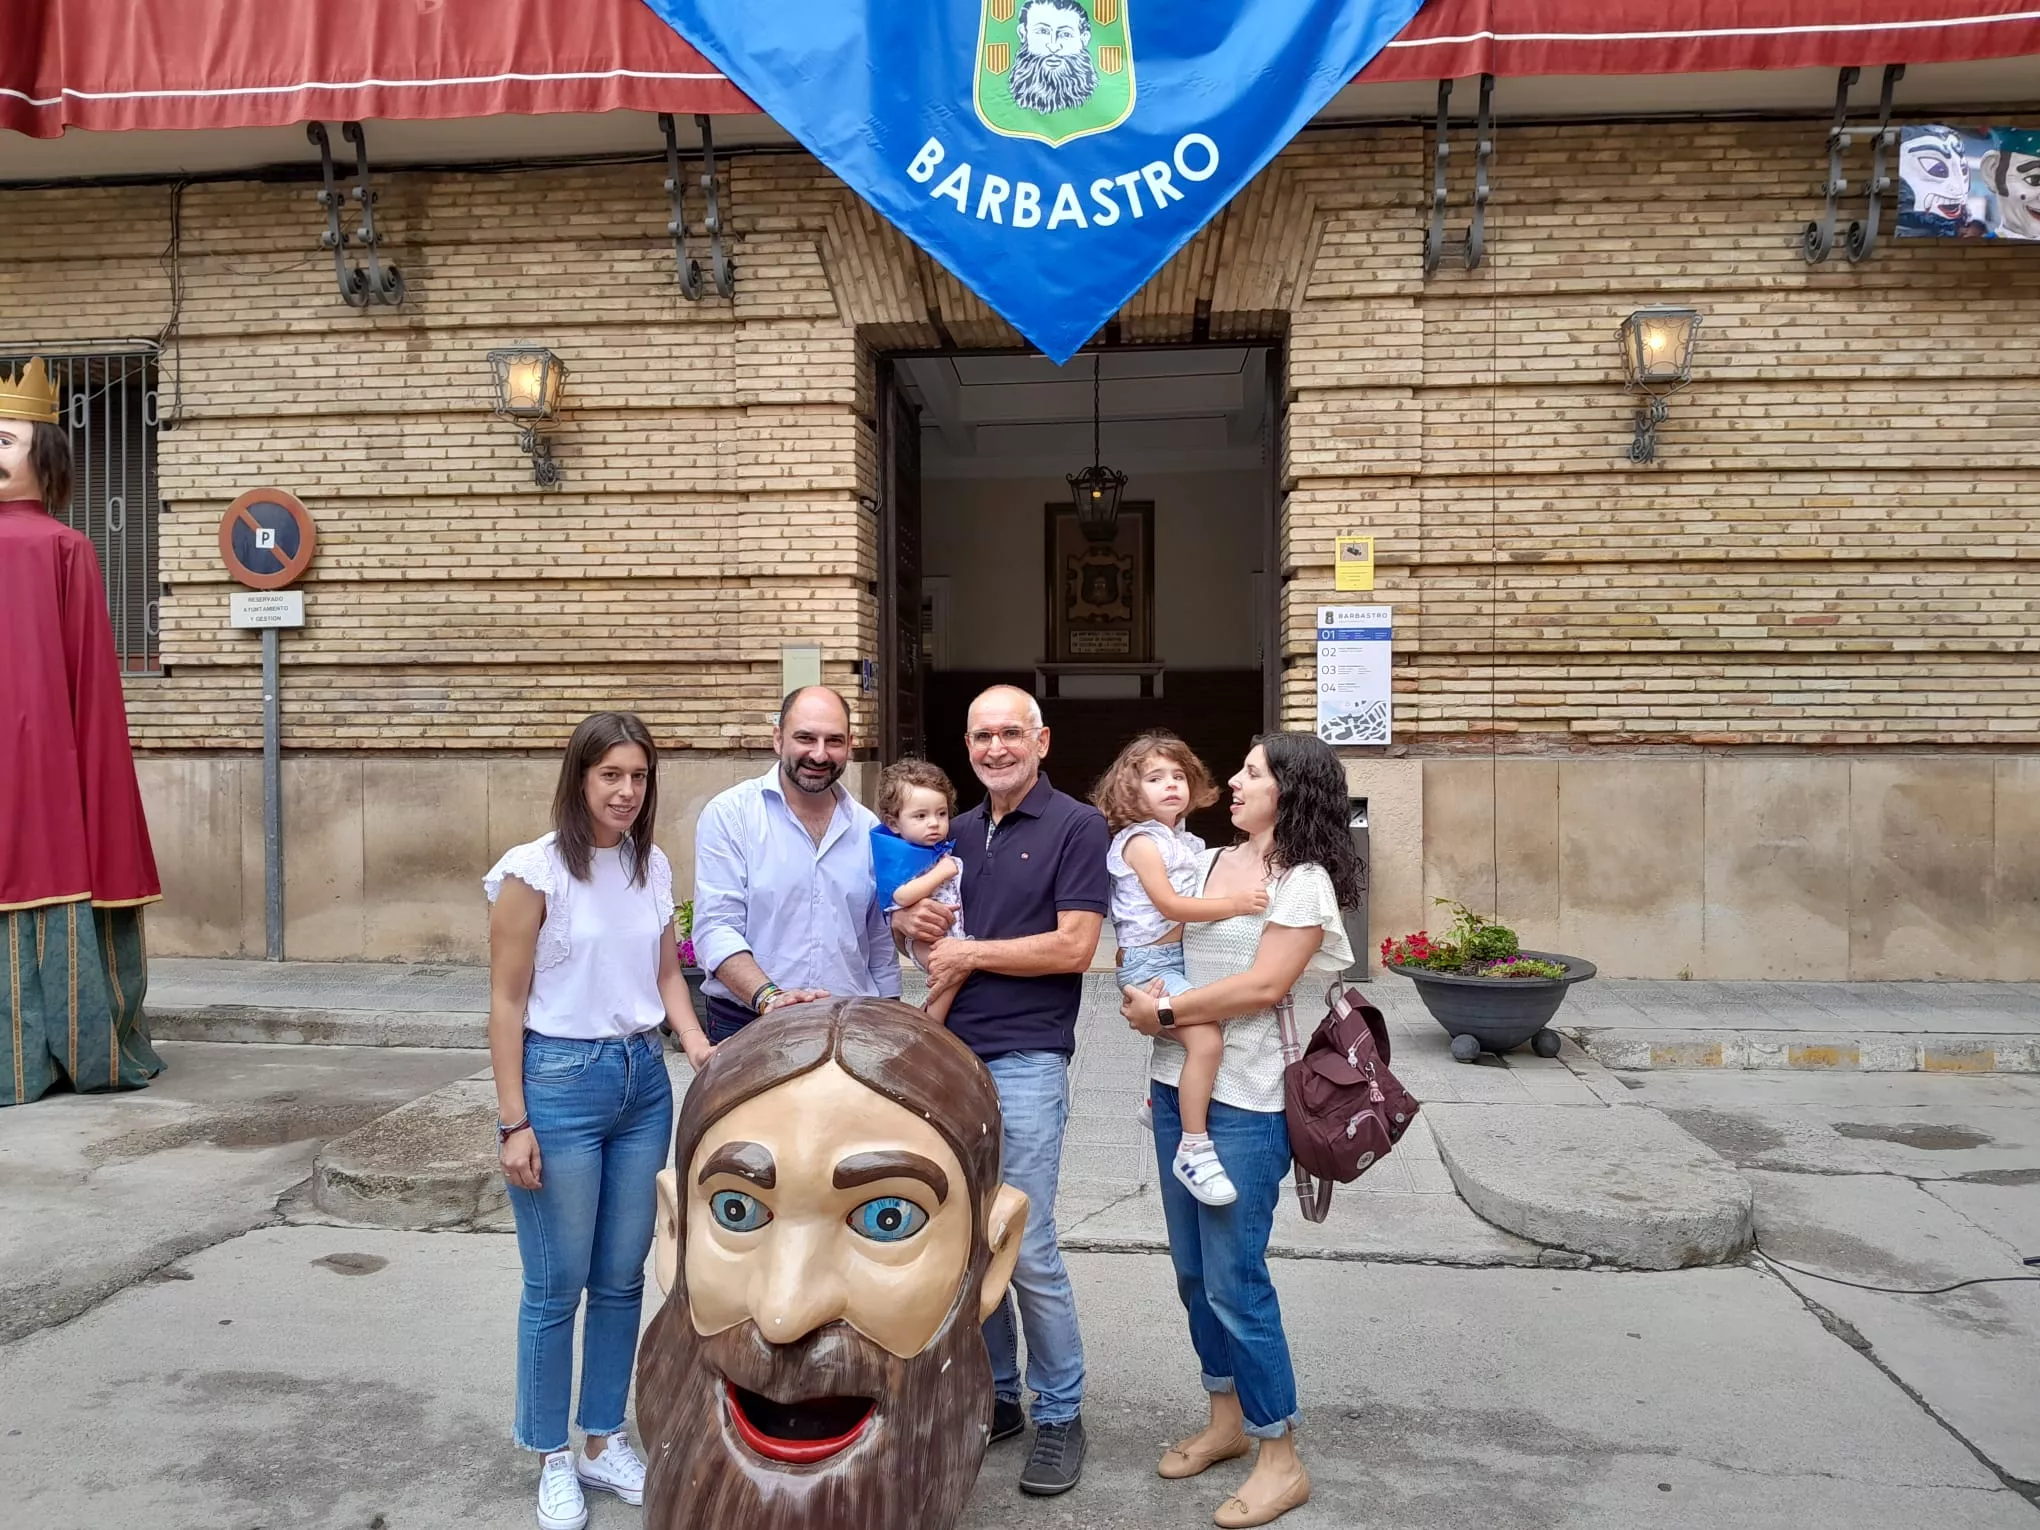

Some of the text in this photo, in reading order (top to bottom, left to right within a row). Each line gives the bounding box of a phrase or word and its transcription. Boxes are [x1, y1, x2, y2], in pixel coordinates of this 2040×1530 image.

[906, 132, 1219, 230] BARBASTRO
[261, 531, 270, 545] P
[1321, 630, 1335, 640] 01
[1321, 648, 1336, 657] 02
[1321, 665, 1336, 675] 03
[1321, 683, 1336, 693] 04
